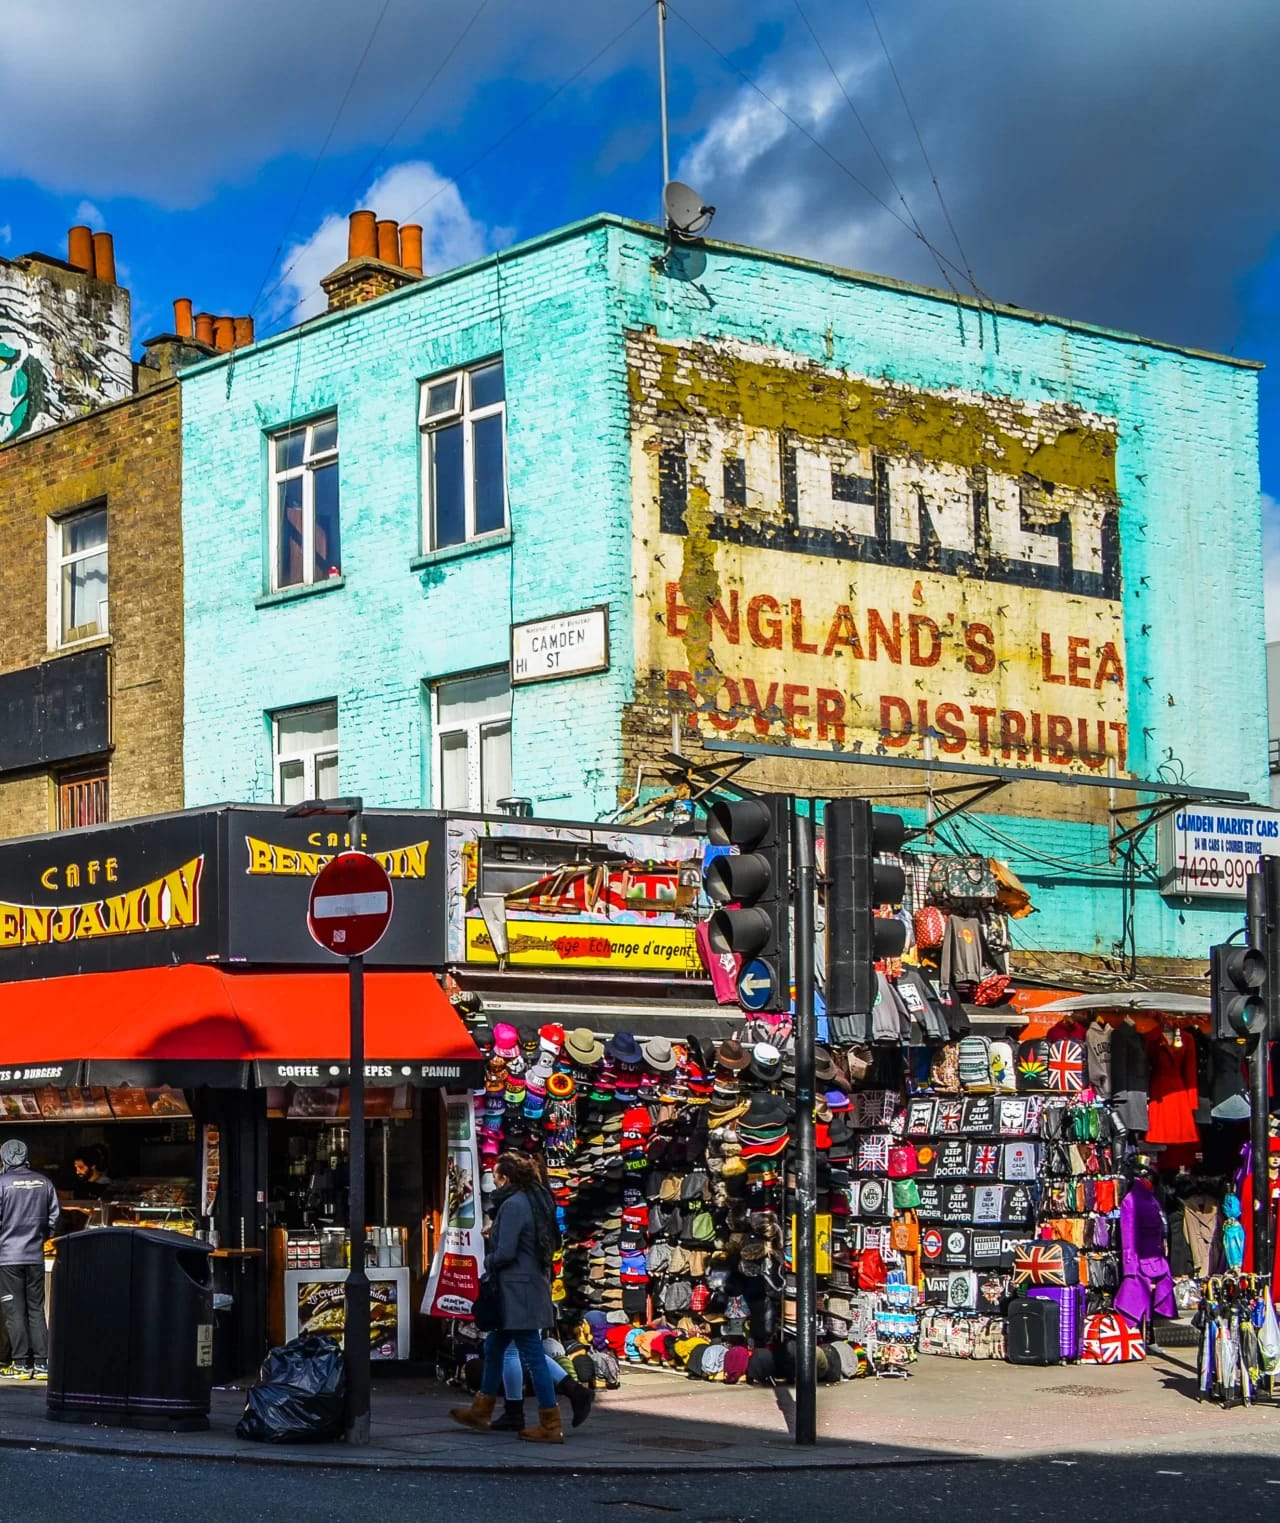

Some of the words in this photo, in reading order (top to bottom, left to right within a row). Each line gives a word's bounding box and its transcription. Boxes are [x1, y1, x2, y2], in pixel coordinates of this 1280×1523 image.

[665, 580, 996, 676] ENGLAND'S
[531, 628, 585, 653] CAMDEN
[546, 651, 561, 668] ST
[1177, 813, 1214, 833] CAMDEN
[1217, 817, 1254, 836] MARKET
[1256, 820, 1279, 837] CARS
[40, 857, 119, 890] CAFE
[1179, 855, 1220, 887] 7428
[589, 938, 640, 958] Echange
[643, 941, 692, 961] d'argent
[23, 1067, 63, 1079] BURGERS
[278, 1066, 320, 1077] COFFEE
[422, 1066, 461, 1077] PANINI
[969, 1113, 990, 1121] CALM
[962, 1124, 993, 1132] ARCHITECT
[626, 1159, 649, 1169] YOLO
[942, 1155, 962, 1163] CALM
[936, 1167, 968, 1176] DOCTOR
[921, 1197, 938, 1205] CALM
[948, 1201, 968, 1209] CALM
[944, 1213, 971, 1221] LAWYER
[926, 1277, 948, 1291] VAN
